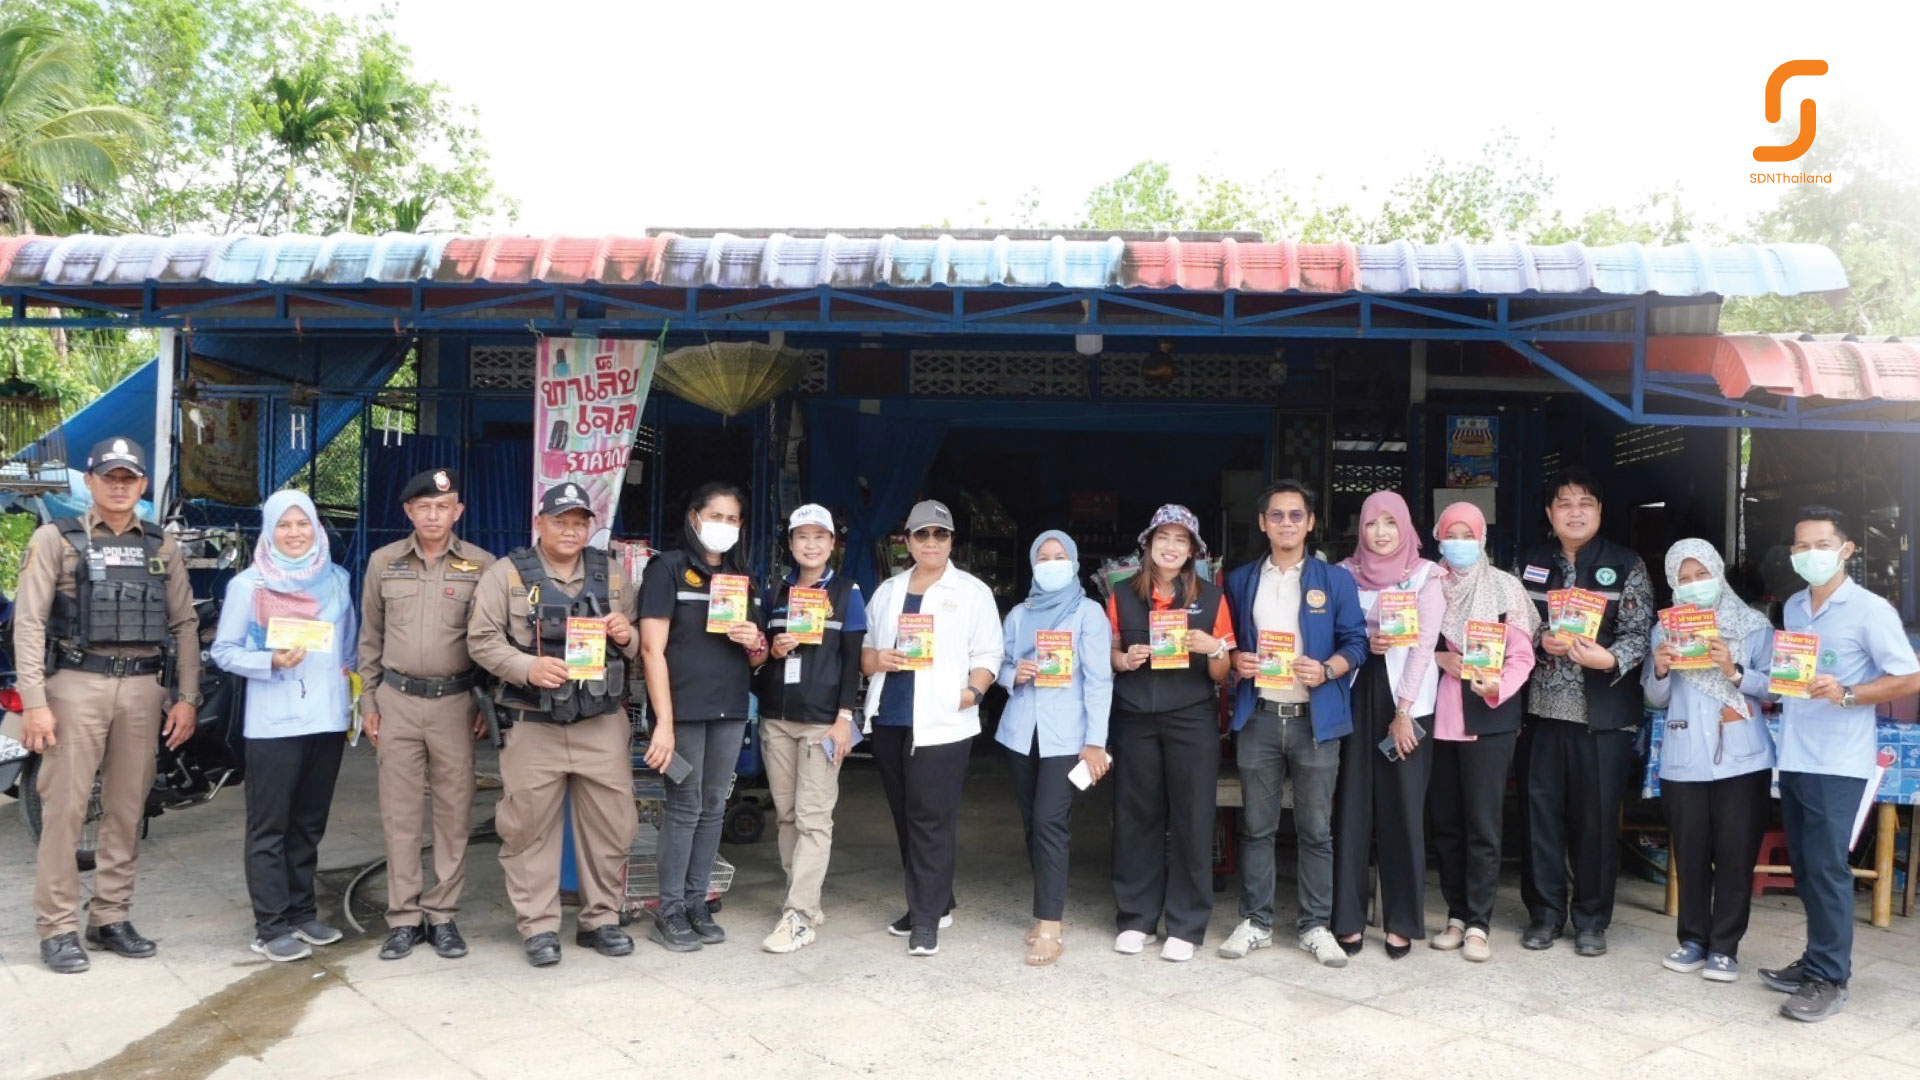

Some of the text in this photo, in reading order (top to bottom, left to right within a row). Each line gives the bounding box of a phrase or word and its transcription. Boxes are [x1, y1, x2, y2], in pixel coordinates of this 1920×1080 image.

[541, 355, 639, 407] ทาเล็บ
[576, 404, 637, 435] เจล
[102, 546, 145, 558] POLICE
